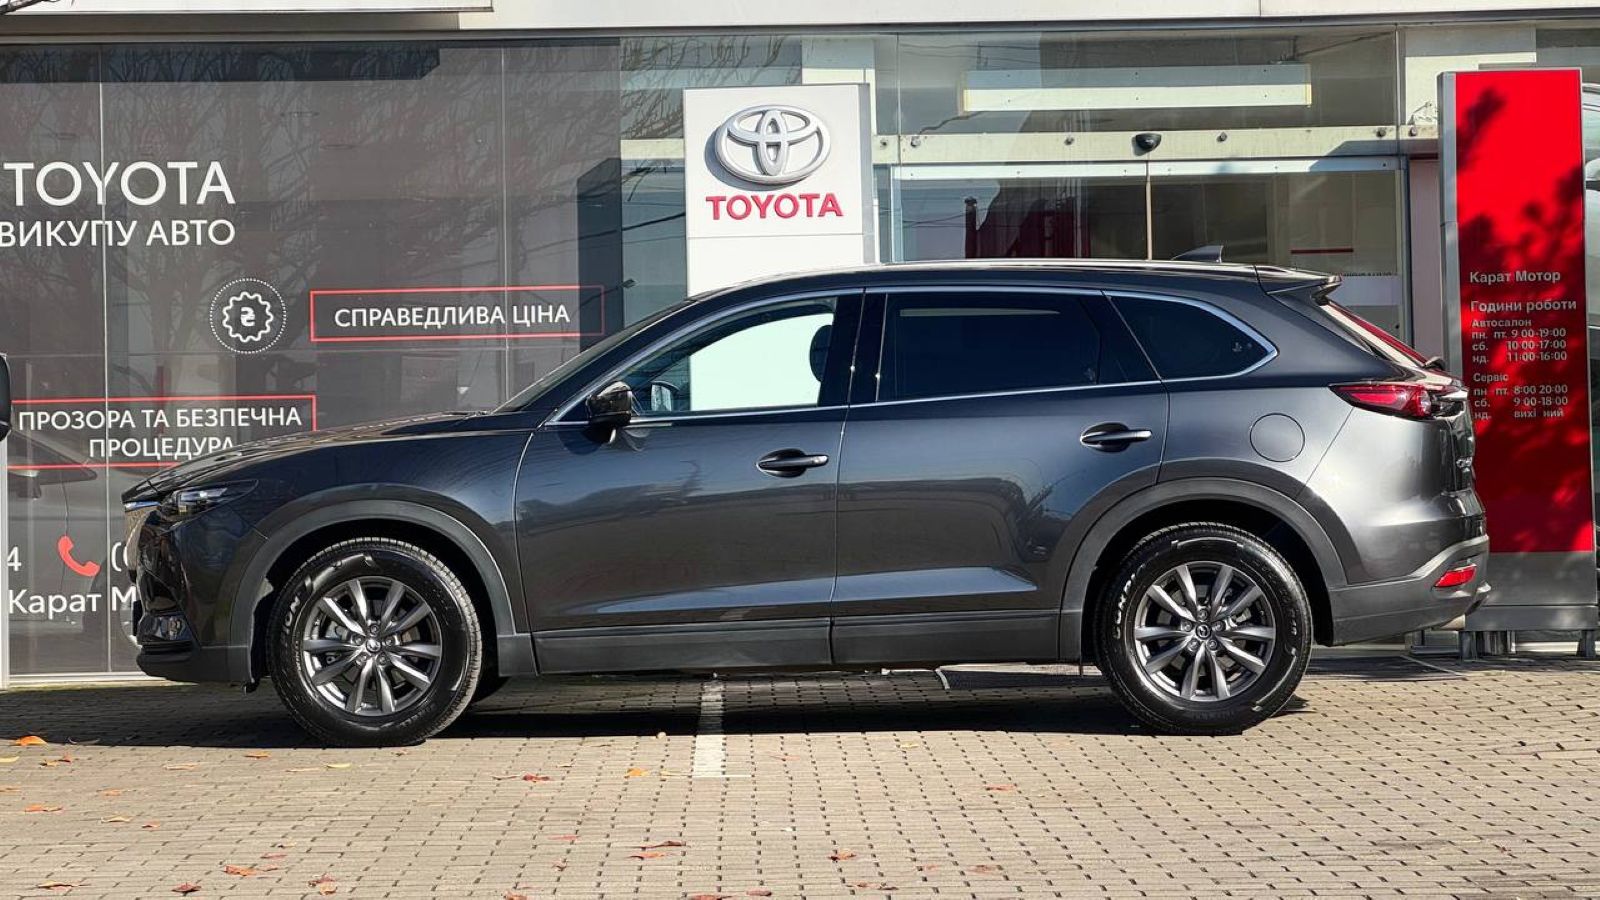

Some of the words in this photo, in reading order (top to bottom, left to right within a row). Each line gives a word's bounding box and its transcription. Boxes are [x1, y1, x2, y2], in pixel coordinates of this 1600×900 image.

[3, 161, 236, 207] TOYOTA
[705, 193, 843, 221] TOYOTA
[0, 220, 137, 247] ВИКУПУ
[146, 219, 236, 246] АВТО
[1470, 271, 1511, 285] Карат
[1515, 270, 1560, 284] Мотор
[334, 304, 506, 329] СПРАВЕДЛИВА
[512, 304, 571, 326] ЦІНА
[1471, 300, 1522, 313] Години
[1526, 298, 1577, 314] роботи
[1472, 319, 1532, 328] Автосалон
[19, 410, 132, 431] ПРОЗОРА
[141, 408, 170, 428] ТА
[176, 406, 302, 428] БЕЗПЕЧНА
[8, 589, 102, 620] Карат
